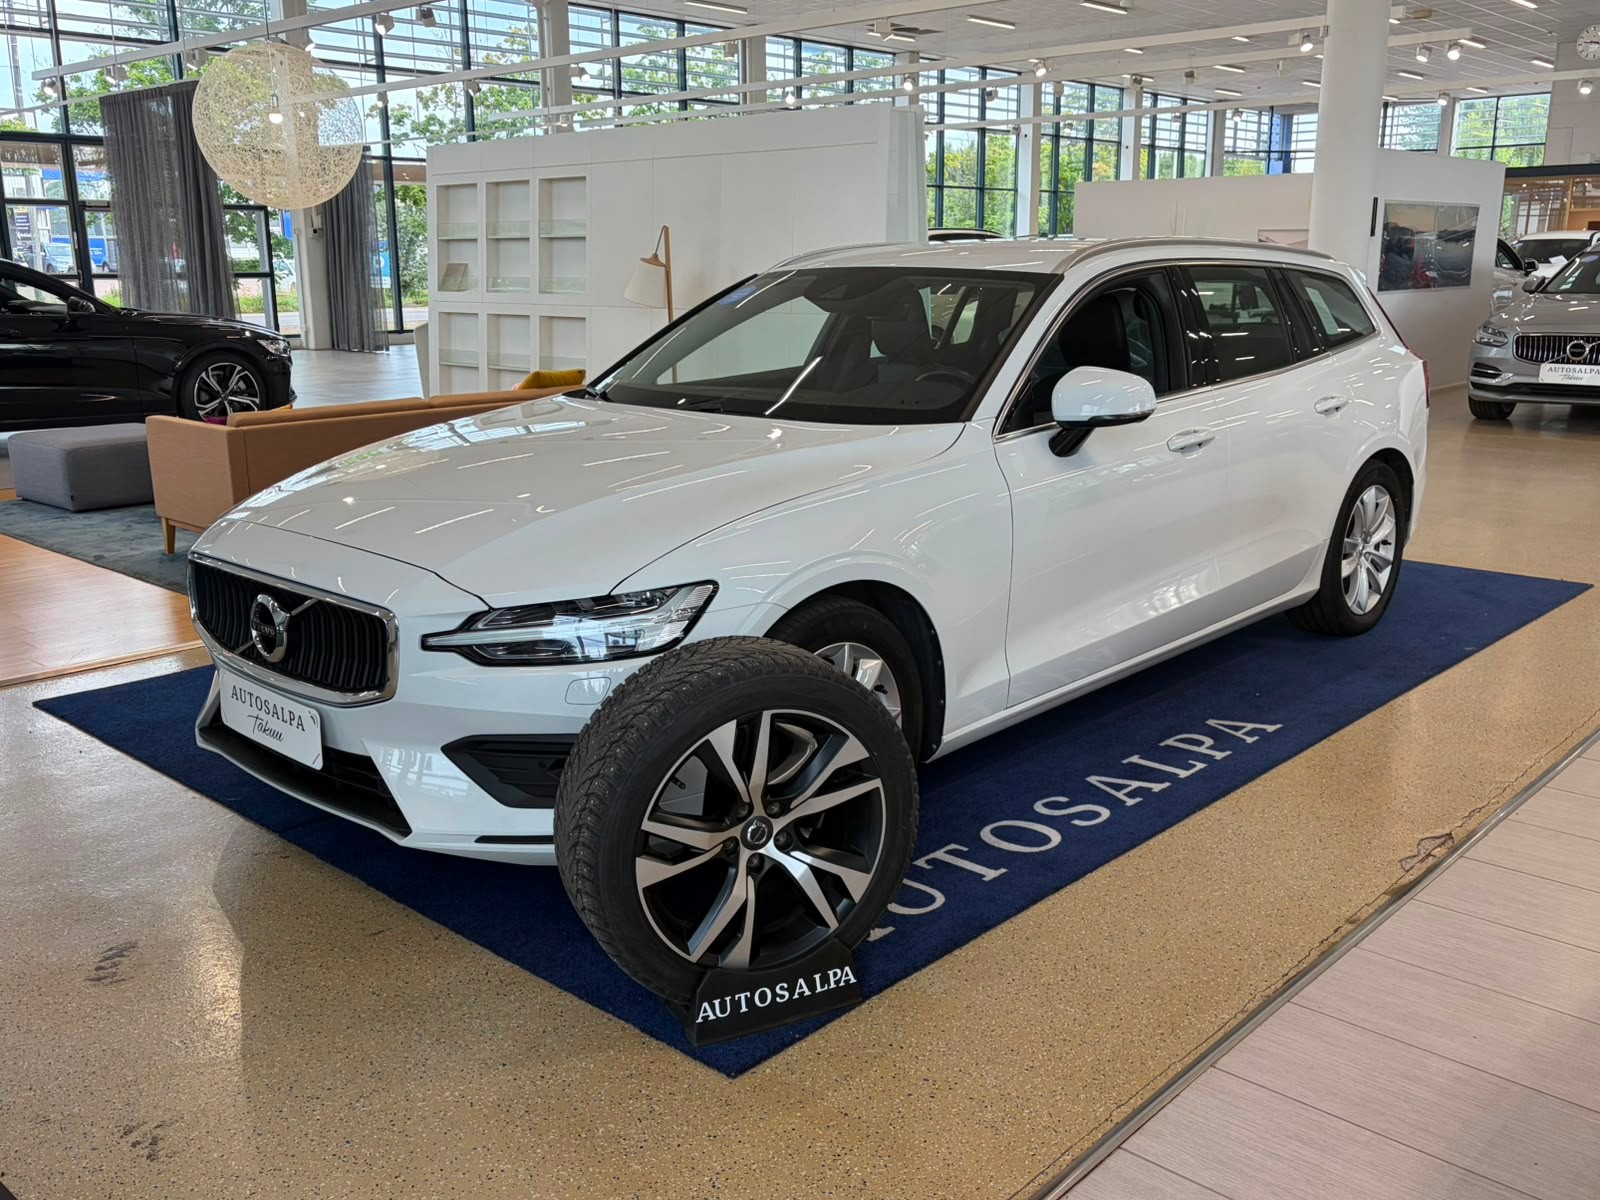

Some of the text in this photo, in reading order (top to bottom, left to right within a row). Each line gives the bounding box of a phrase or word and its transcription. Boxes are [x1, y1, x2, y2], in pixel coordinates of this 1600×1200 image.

[231, 685, 306, 732] AUTOSALPA
[247, 714, 284, 742] Takuu
[867, 718, 1283, 942] UTOSALPA
[696, 965, 857, 1023] AUTOSALPA
